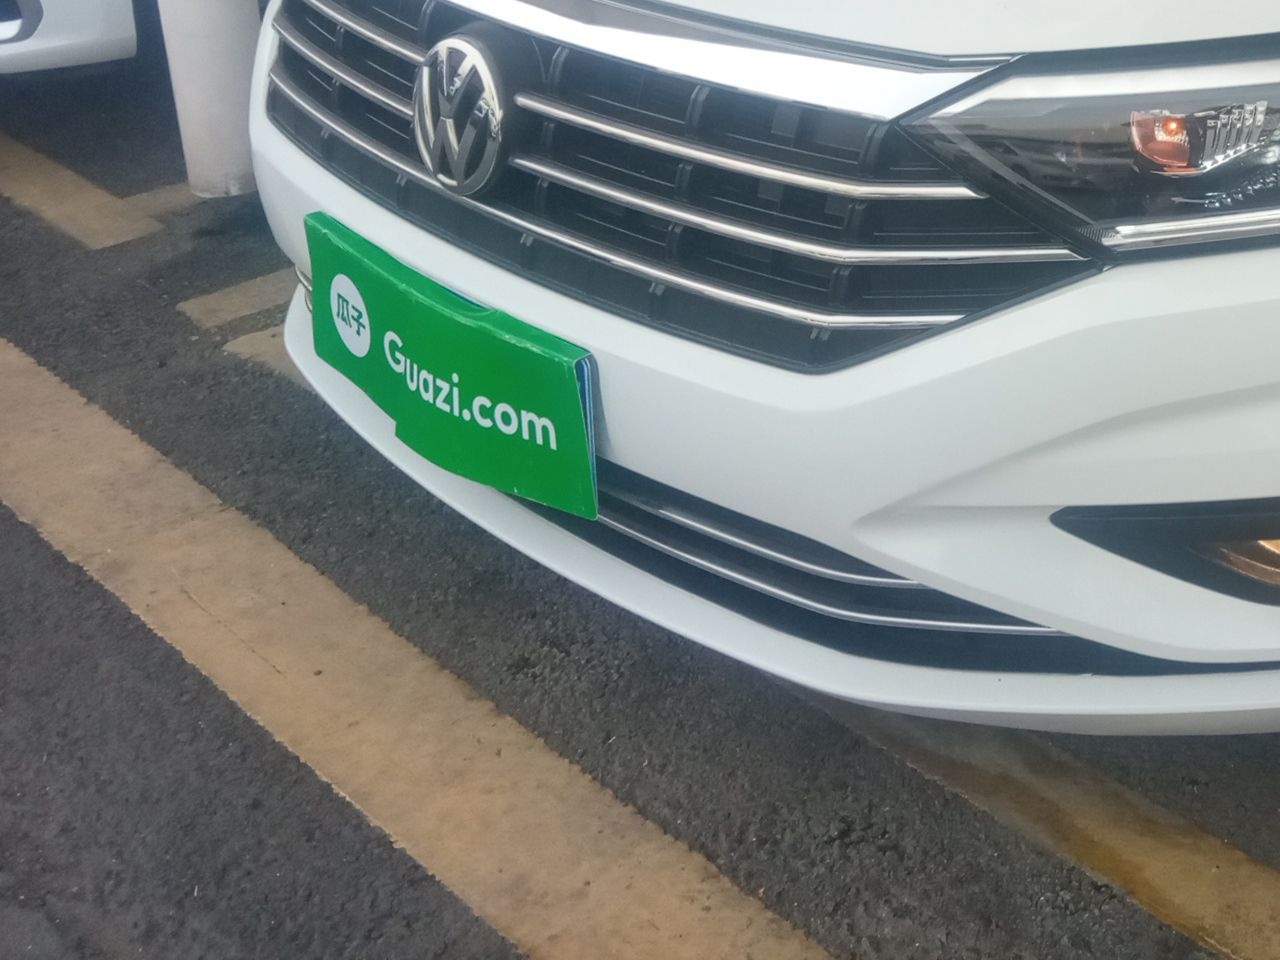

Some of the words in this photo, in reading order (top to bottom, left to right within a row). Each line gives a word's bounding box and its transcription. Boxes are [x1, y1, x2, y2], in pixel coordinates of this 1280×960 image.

[412, 38, 502, 196] VW
[336, 292, 366, 336] 瓜子
[383, 330, 558, 451] Guazi.com
